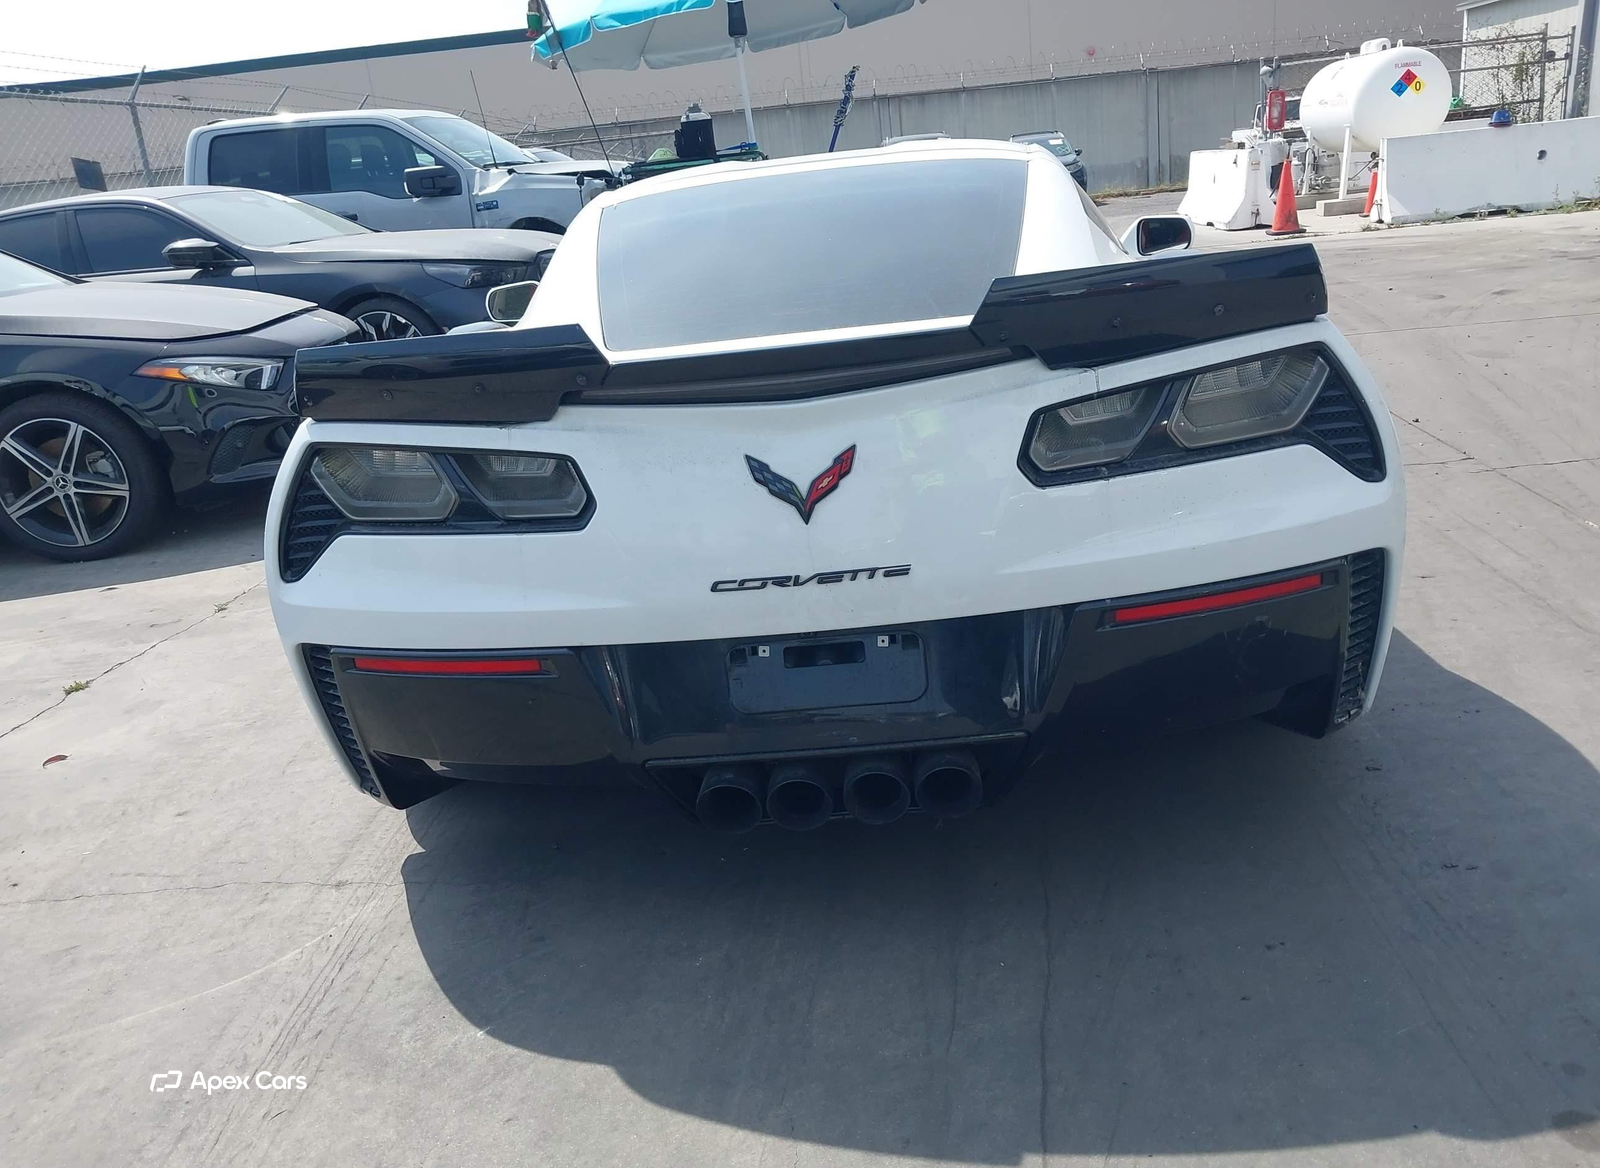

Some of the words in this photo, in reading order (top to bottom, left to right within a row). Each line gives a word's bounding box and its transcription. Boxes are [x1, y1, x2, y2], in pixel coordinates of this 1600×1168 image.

[1395, 61, 1421, 69] FLAMMABLE
[1405, 72, 1411, 82] 4
[1396, 82, 1403, 93] 2
[1415, 81, 1421, 91] 0
[710, 563, 912, 592] CORVETTE
